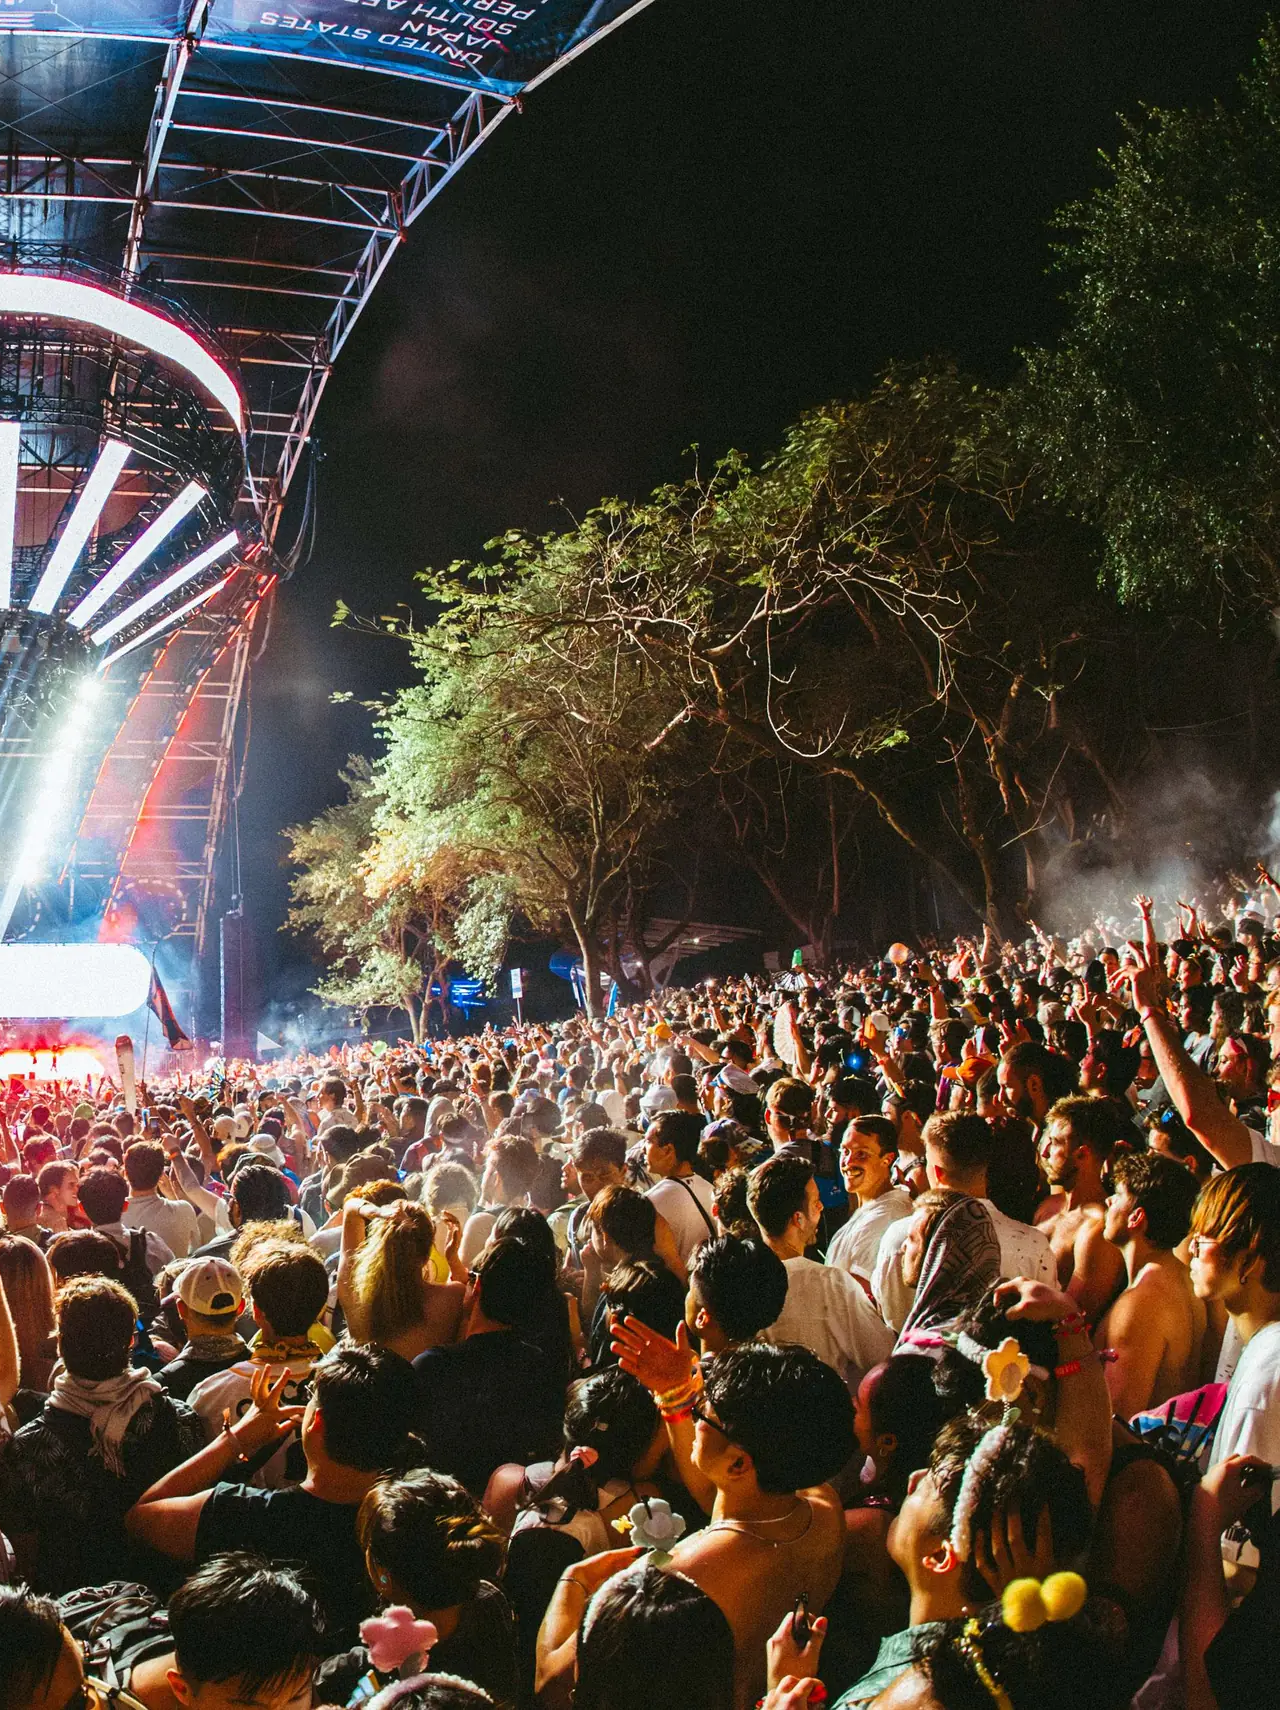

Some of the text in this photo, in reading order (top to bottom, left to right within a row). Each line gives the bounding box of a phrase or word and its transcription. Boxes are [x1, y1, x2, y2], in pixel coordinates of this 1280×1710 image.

[400, 20, 501, 50] JAPAN
[412, 3, 517, 36] SOUTH
[260, 11, 483, 65] UNITED STATES
